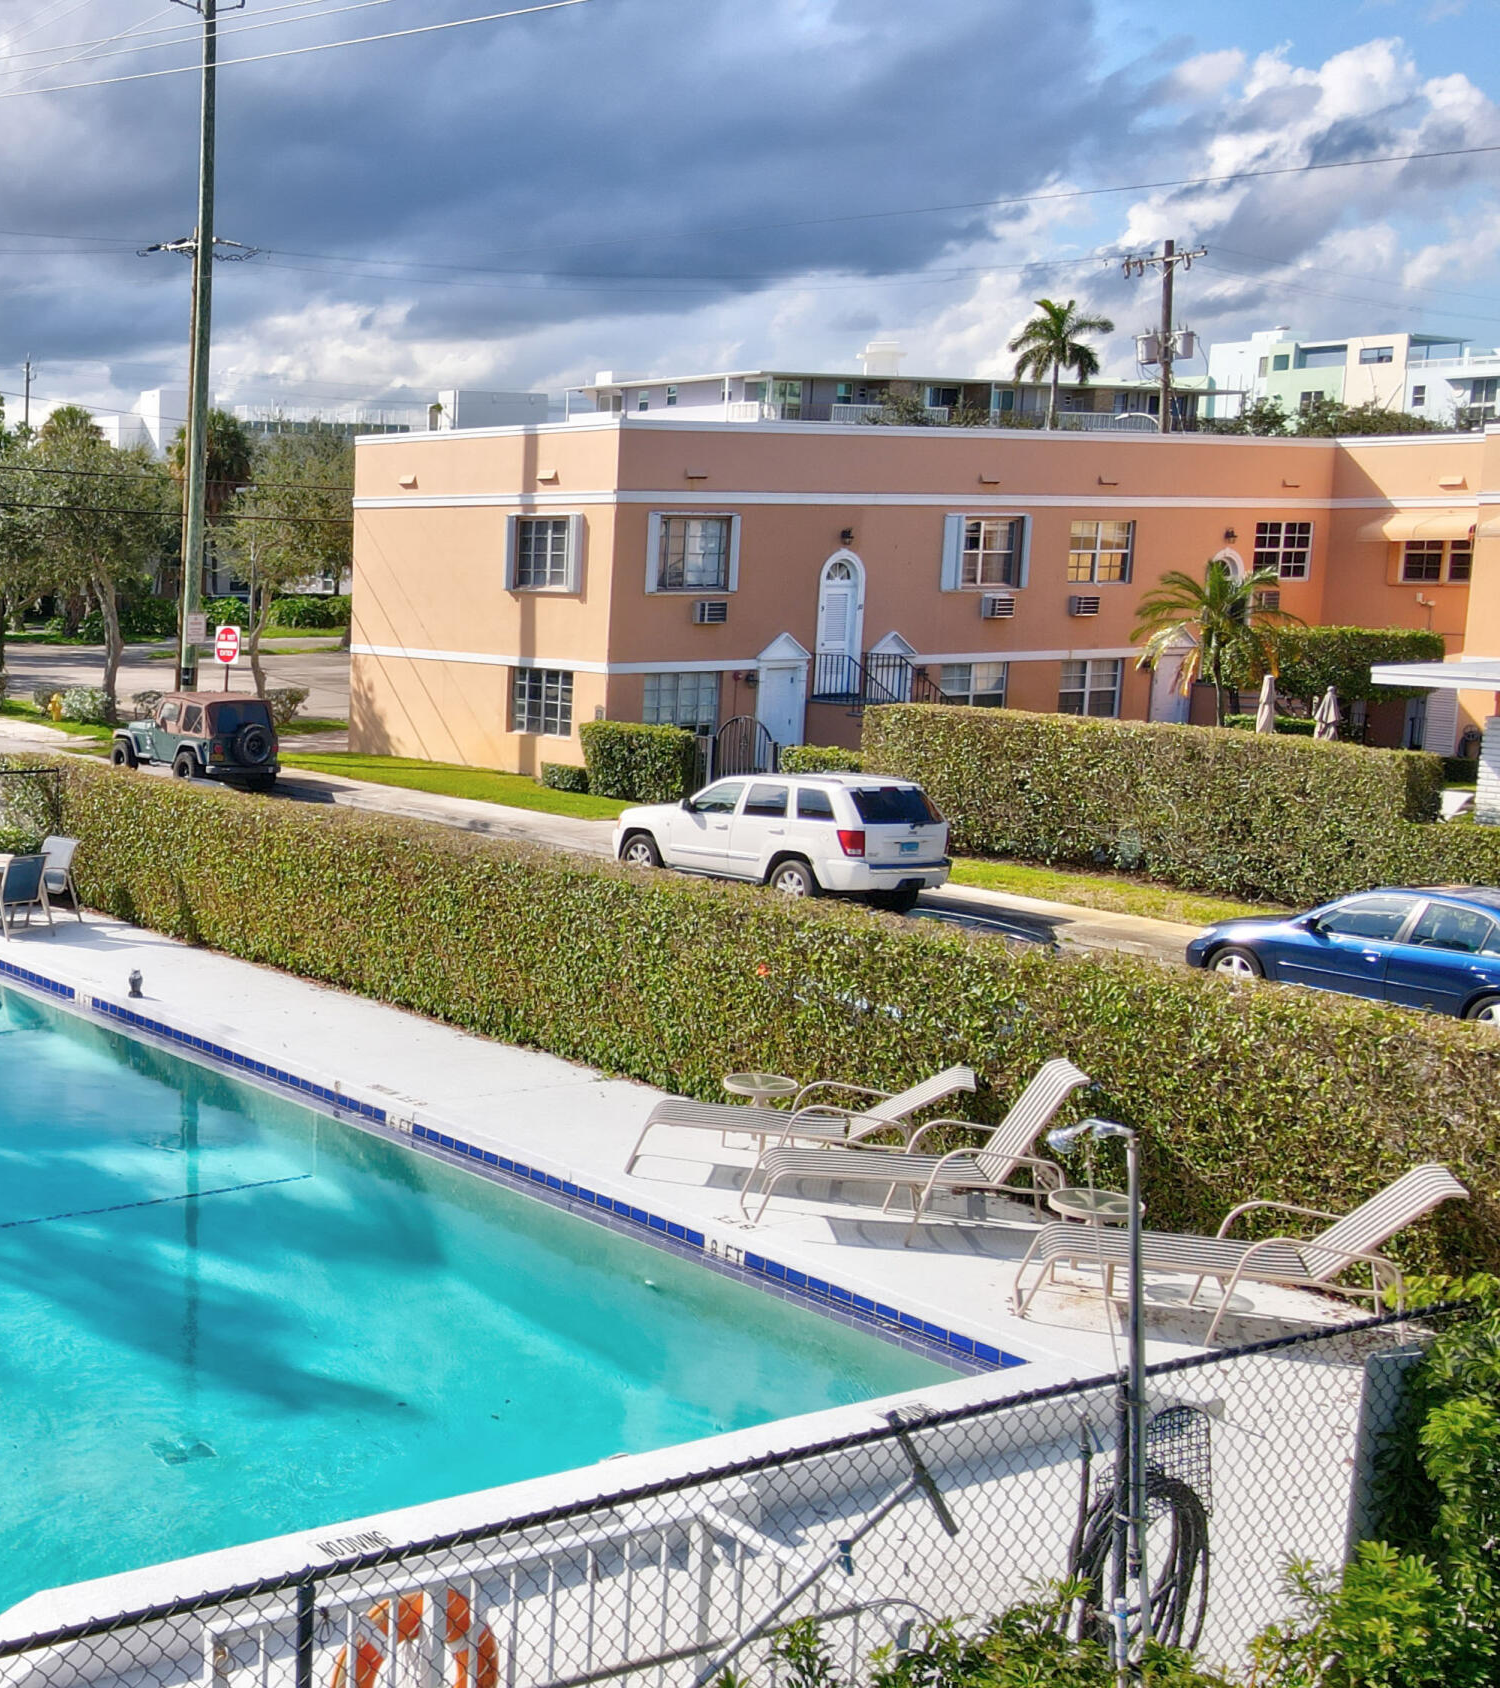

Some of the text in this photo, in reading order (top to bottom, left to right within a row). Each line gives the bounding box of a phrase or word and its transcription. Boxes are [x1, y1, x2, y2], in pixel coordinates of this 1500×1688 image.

[725, 1244, 743, 1262] FT
[316, 1530, 393, 1558] NO DIVING
